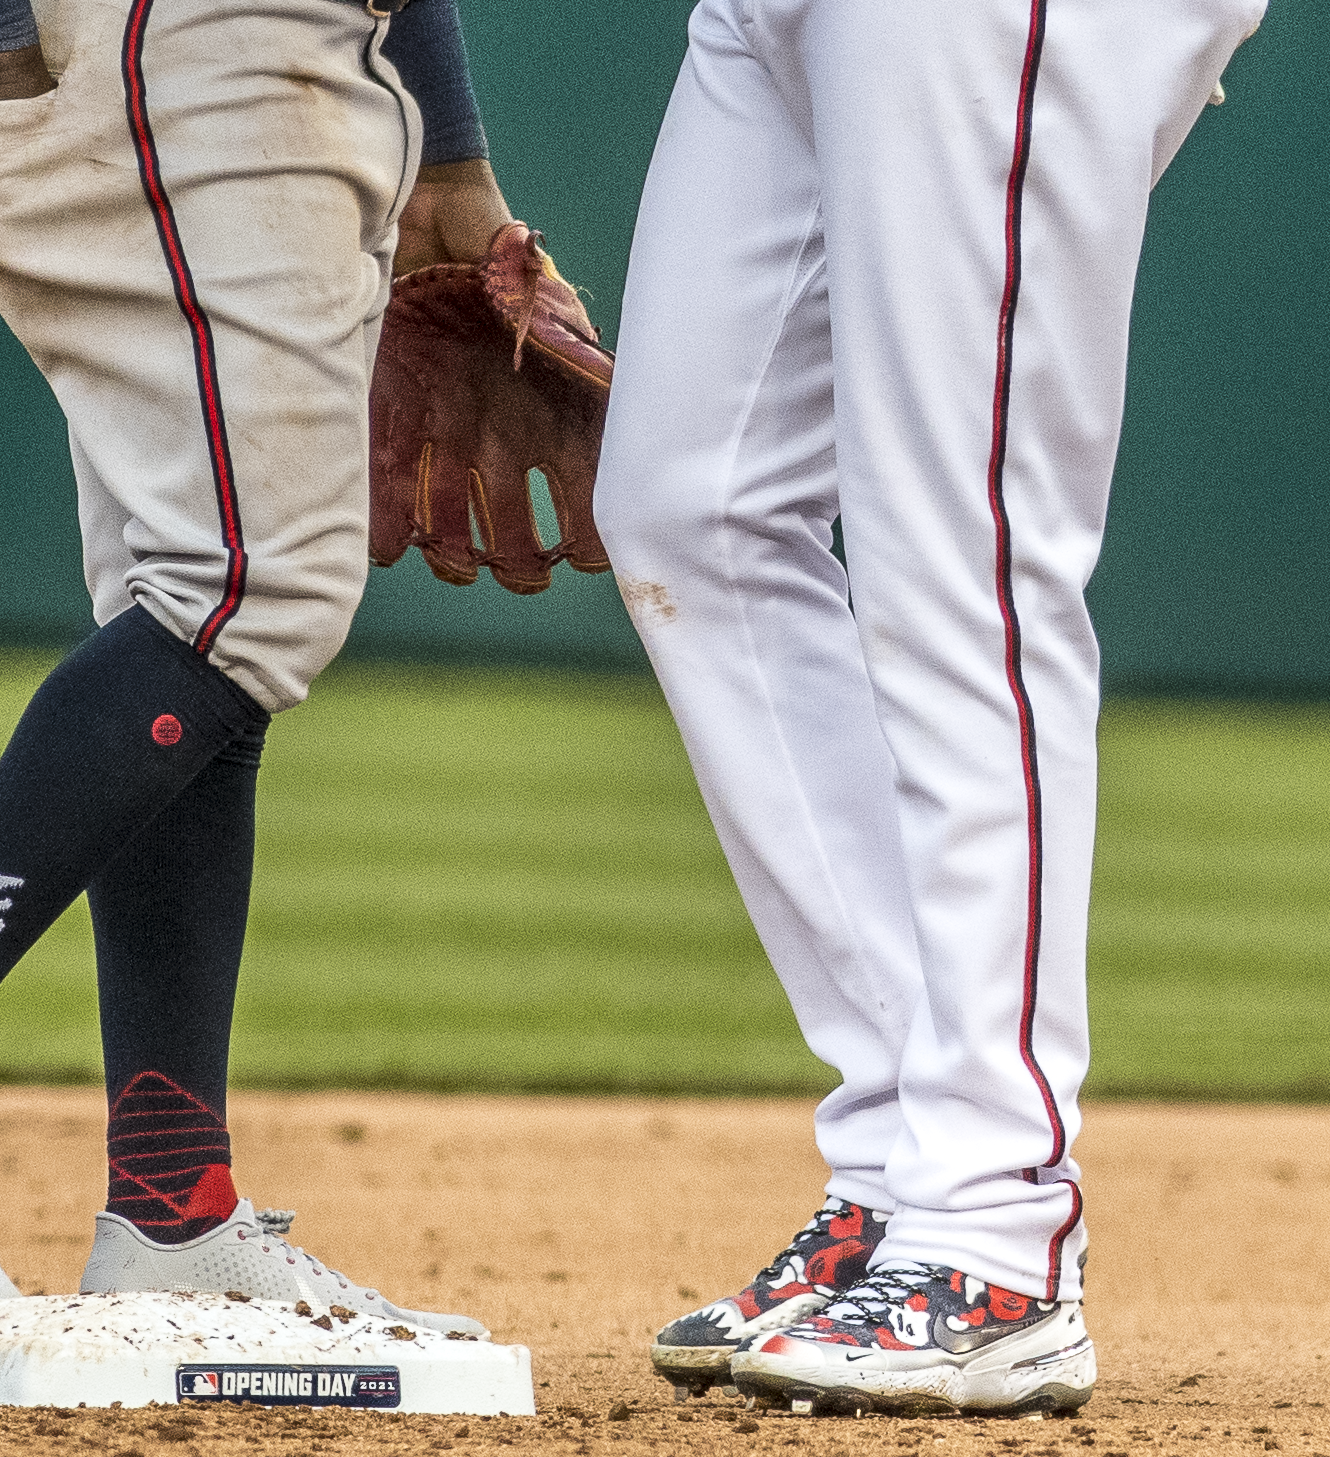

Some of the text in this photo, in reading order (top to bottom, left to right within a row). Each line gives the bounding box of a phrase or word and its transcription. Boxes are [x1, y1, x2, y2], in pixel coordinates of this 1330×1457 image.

[222, 1371, 396, 1397] OPENING DAY 2021
